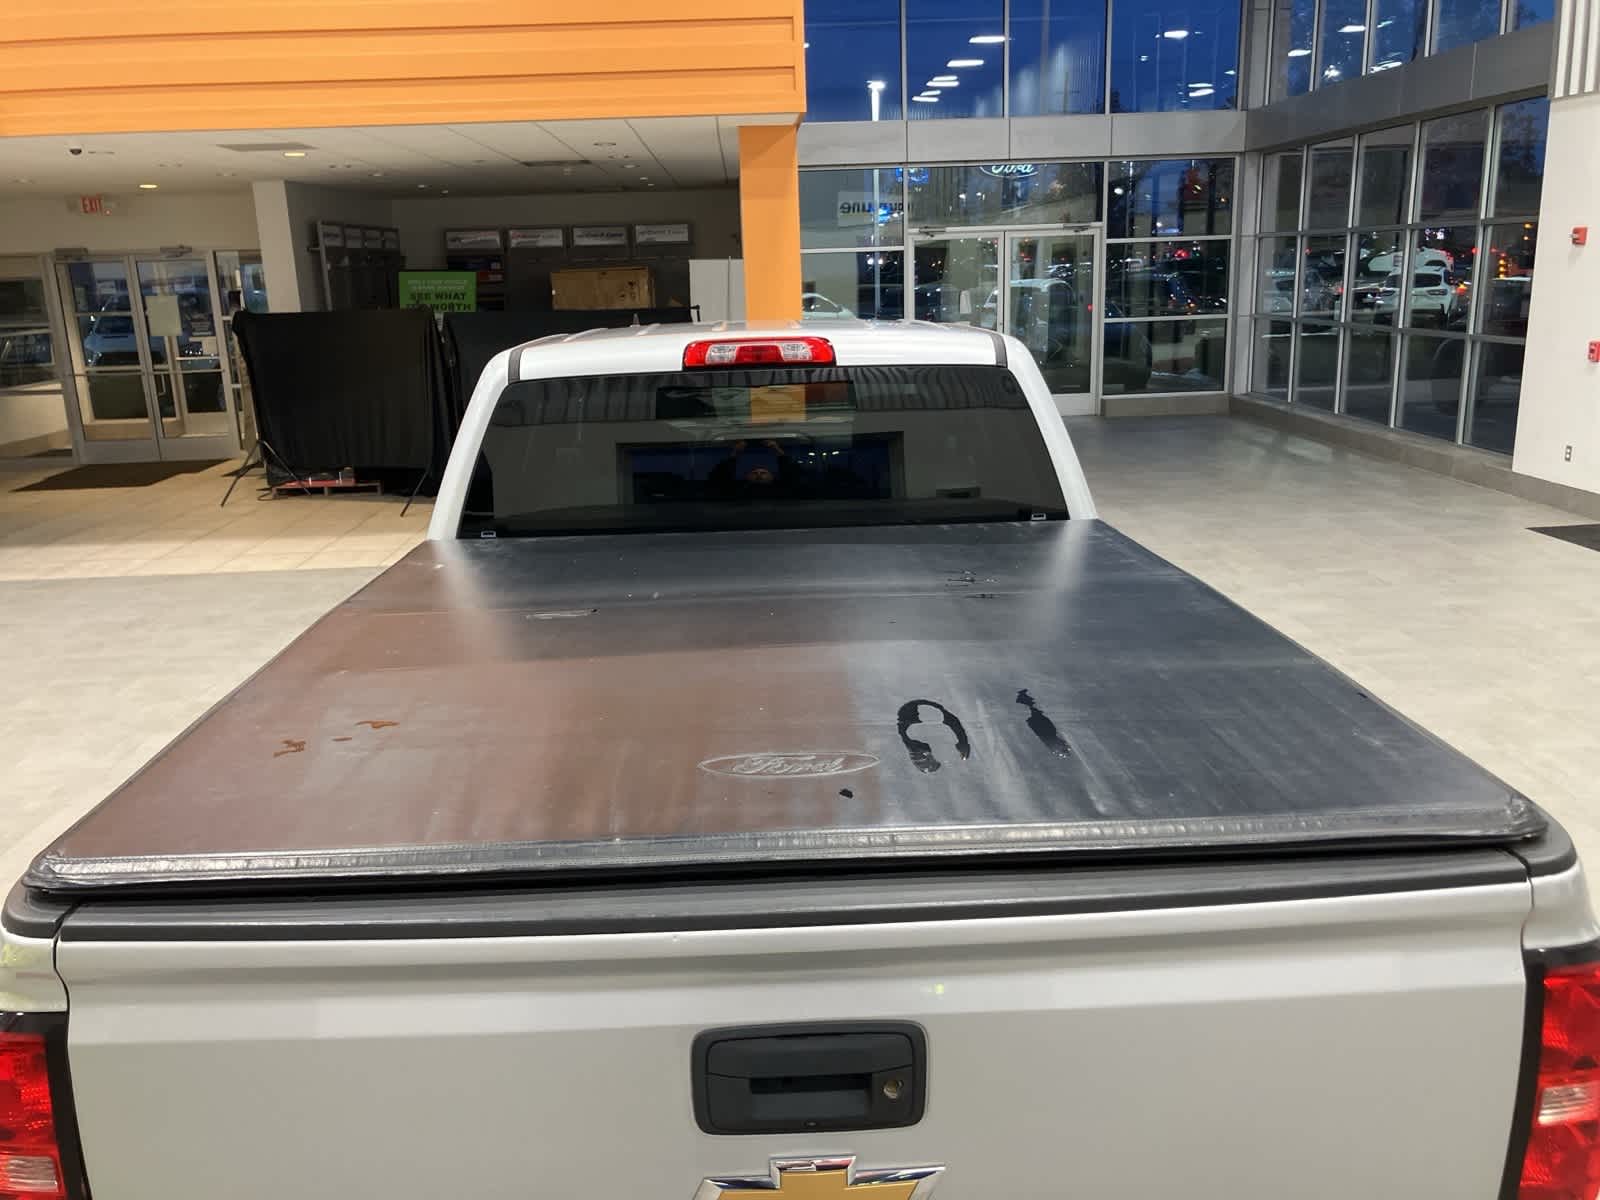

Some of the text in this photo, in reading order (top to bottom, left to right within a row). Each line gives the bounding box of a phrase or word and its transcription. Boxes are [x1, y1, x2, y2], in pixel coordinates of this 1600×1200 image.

[80, 195, 103, 214] EXIT
[409, 291, 466, 300] SEE WHAT
